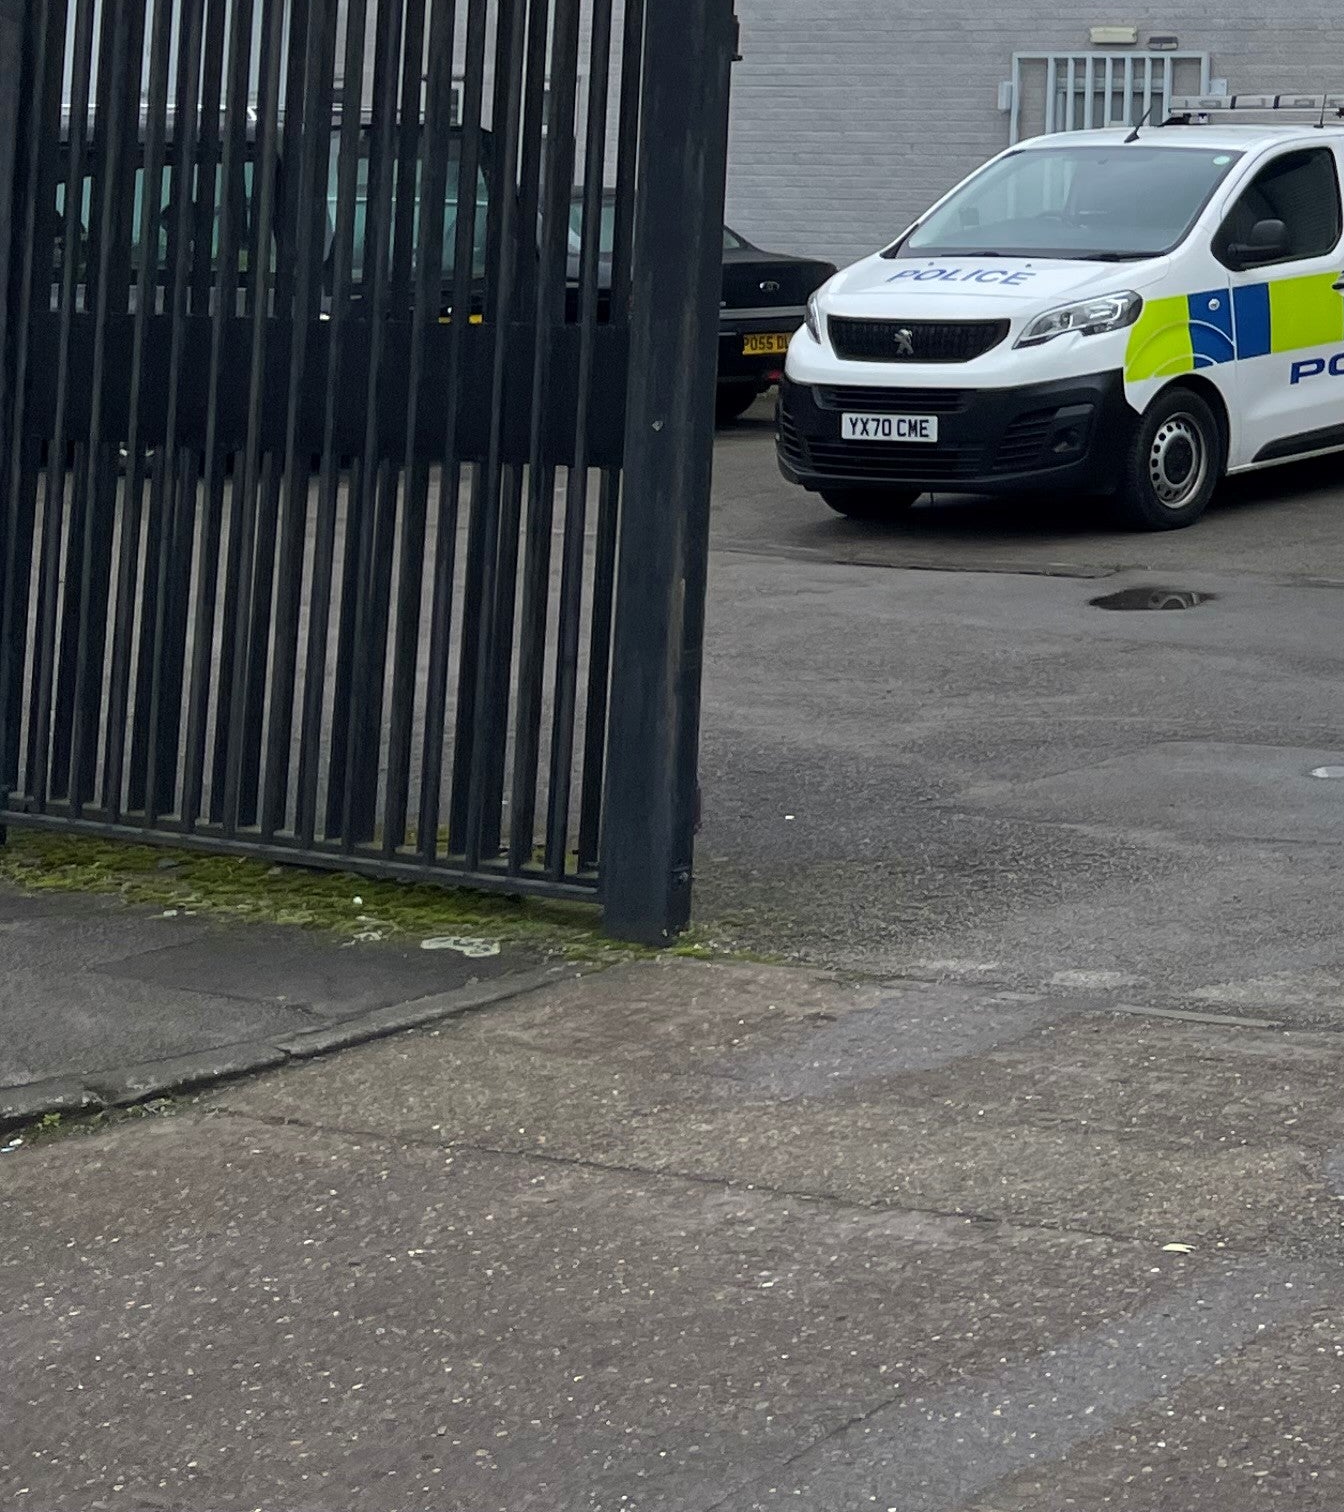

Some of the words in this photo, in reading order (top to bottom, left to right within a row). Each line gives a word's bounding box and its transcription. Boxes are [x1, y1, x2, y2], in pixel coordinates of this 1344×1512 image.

[886, 269, 1037, 285] POLICE
[848, 416, 892, 437] YX70
[897, 418, 930, 438] CME
